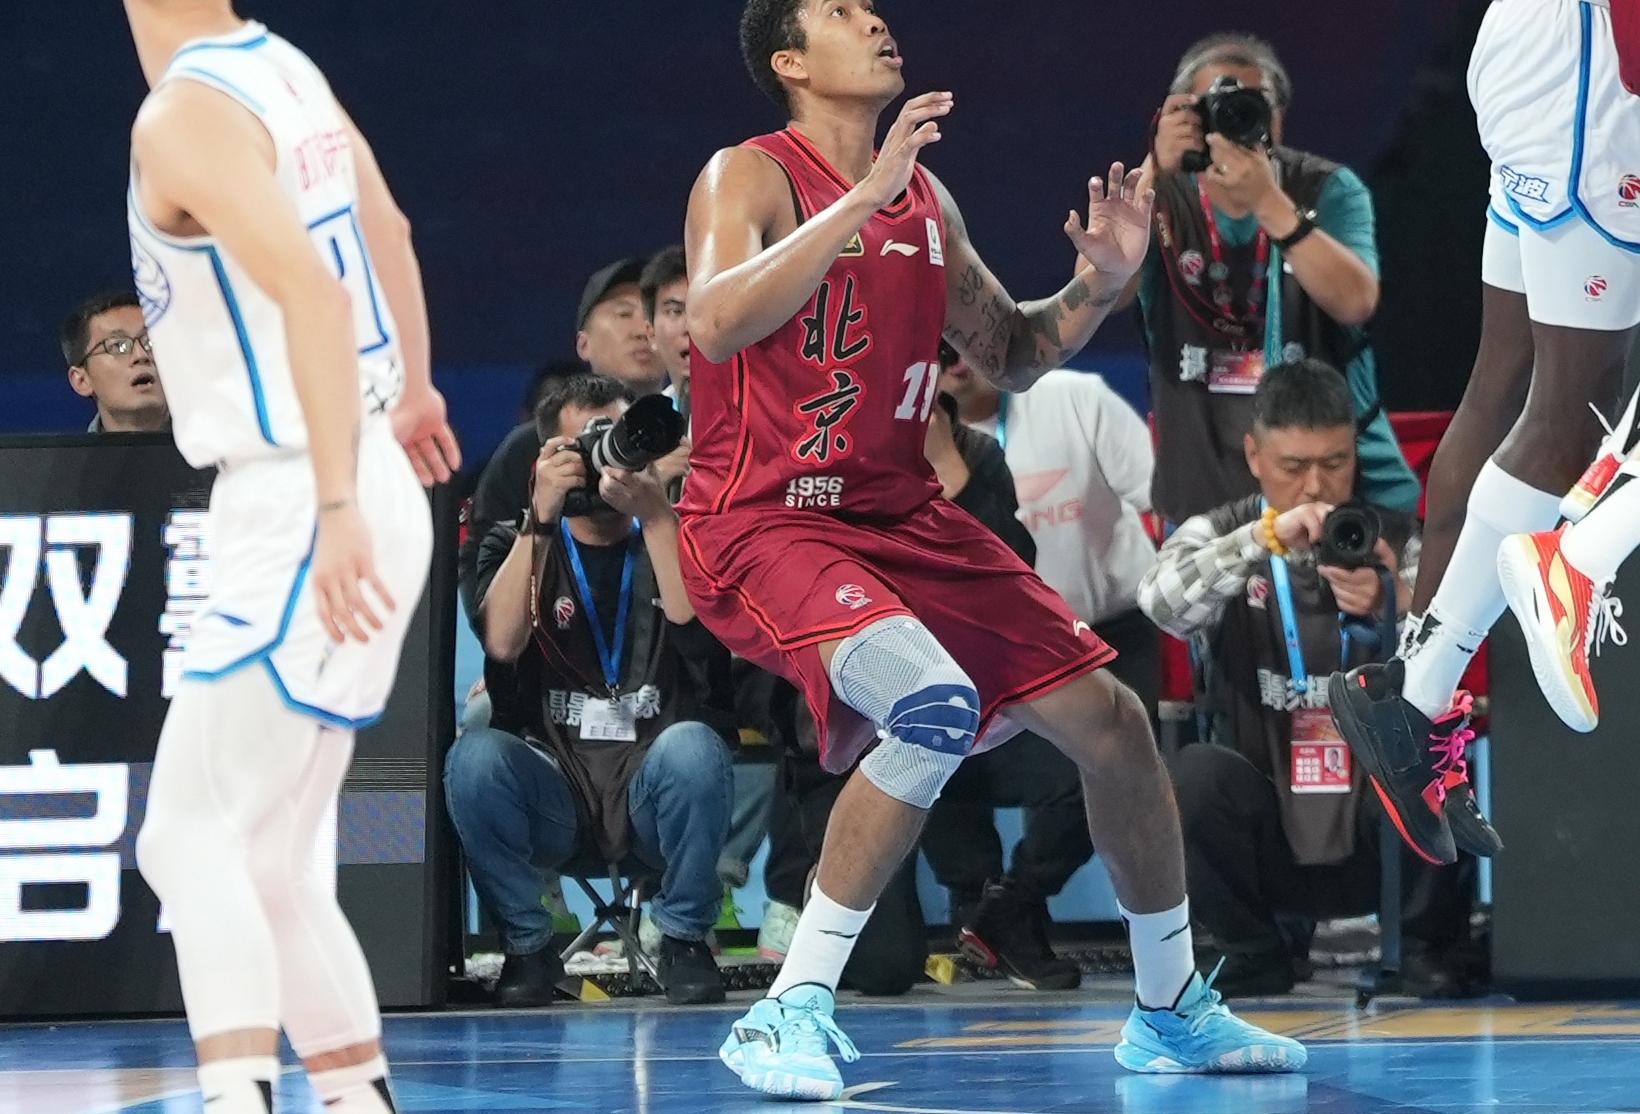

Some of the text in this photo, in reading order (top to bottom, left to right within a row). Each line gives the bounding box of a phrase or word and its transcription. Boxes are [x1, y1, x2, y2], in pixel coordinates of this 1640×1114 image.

[796, 272, 872, 464] 北京
[786, 476, 845, 496] 1956
[785, 494, 841, 509] SINCE
